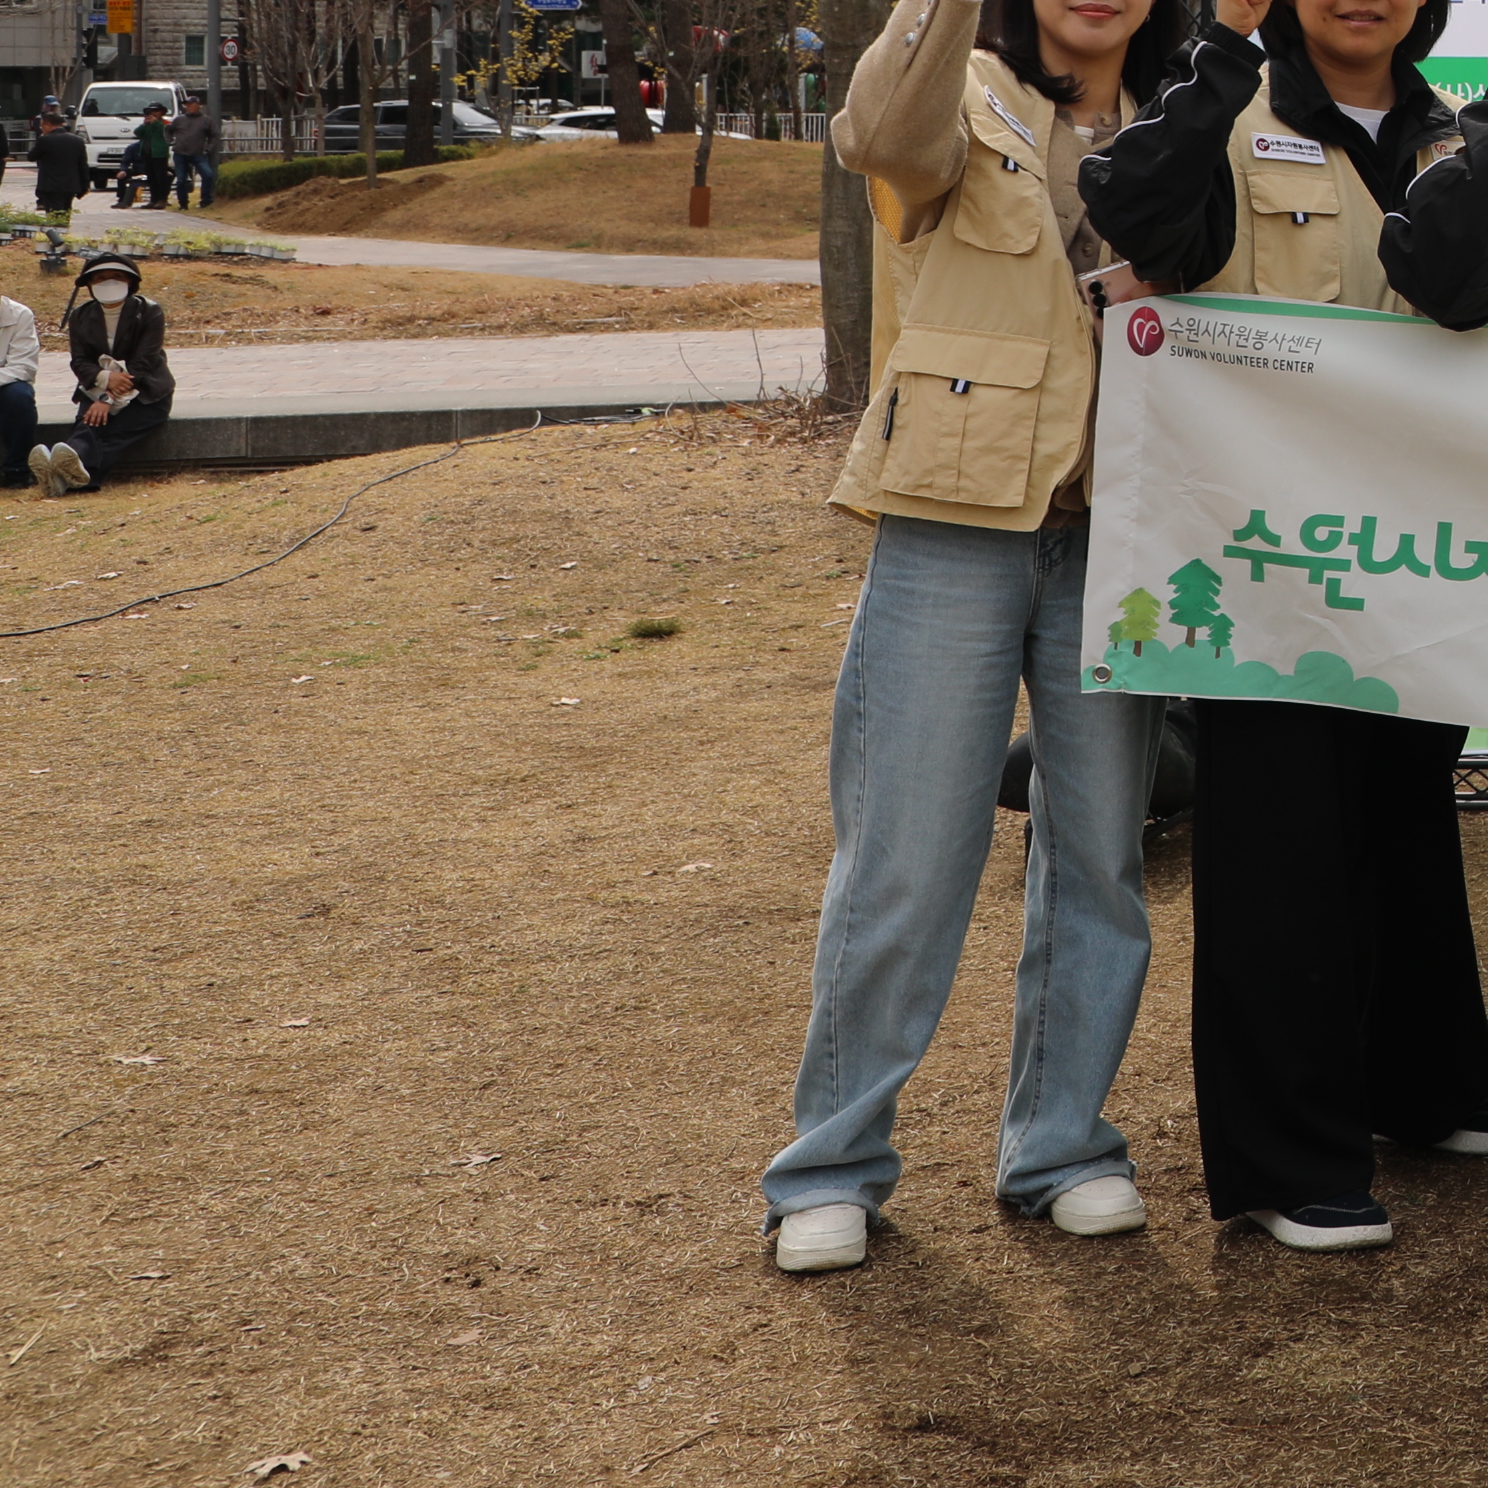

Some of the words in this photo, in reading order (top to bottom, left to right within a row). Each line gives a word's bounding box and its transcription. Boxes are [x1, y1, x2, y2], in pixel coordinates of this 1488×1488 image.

[225, 45, 236, 55] 30
[1168, 317, 1323, 355] 수원시자원봉사센터
[1169, 345, 1208, 360] SUWON
[1209, 349, 1270, 369] VOLUNTEER
[1272, 358, 1315, 374] CENTER
